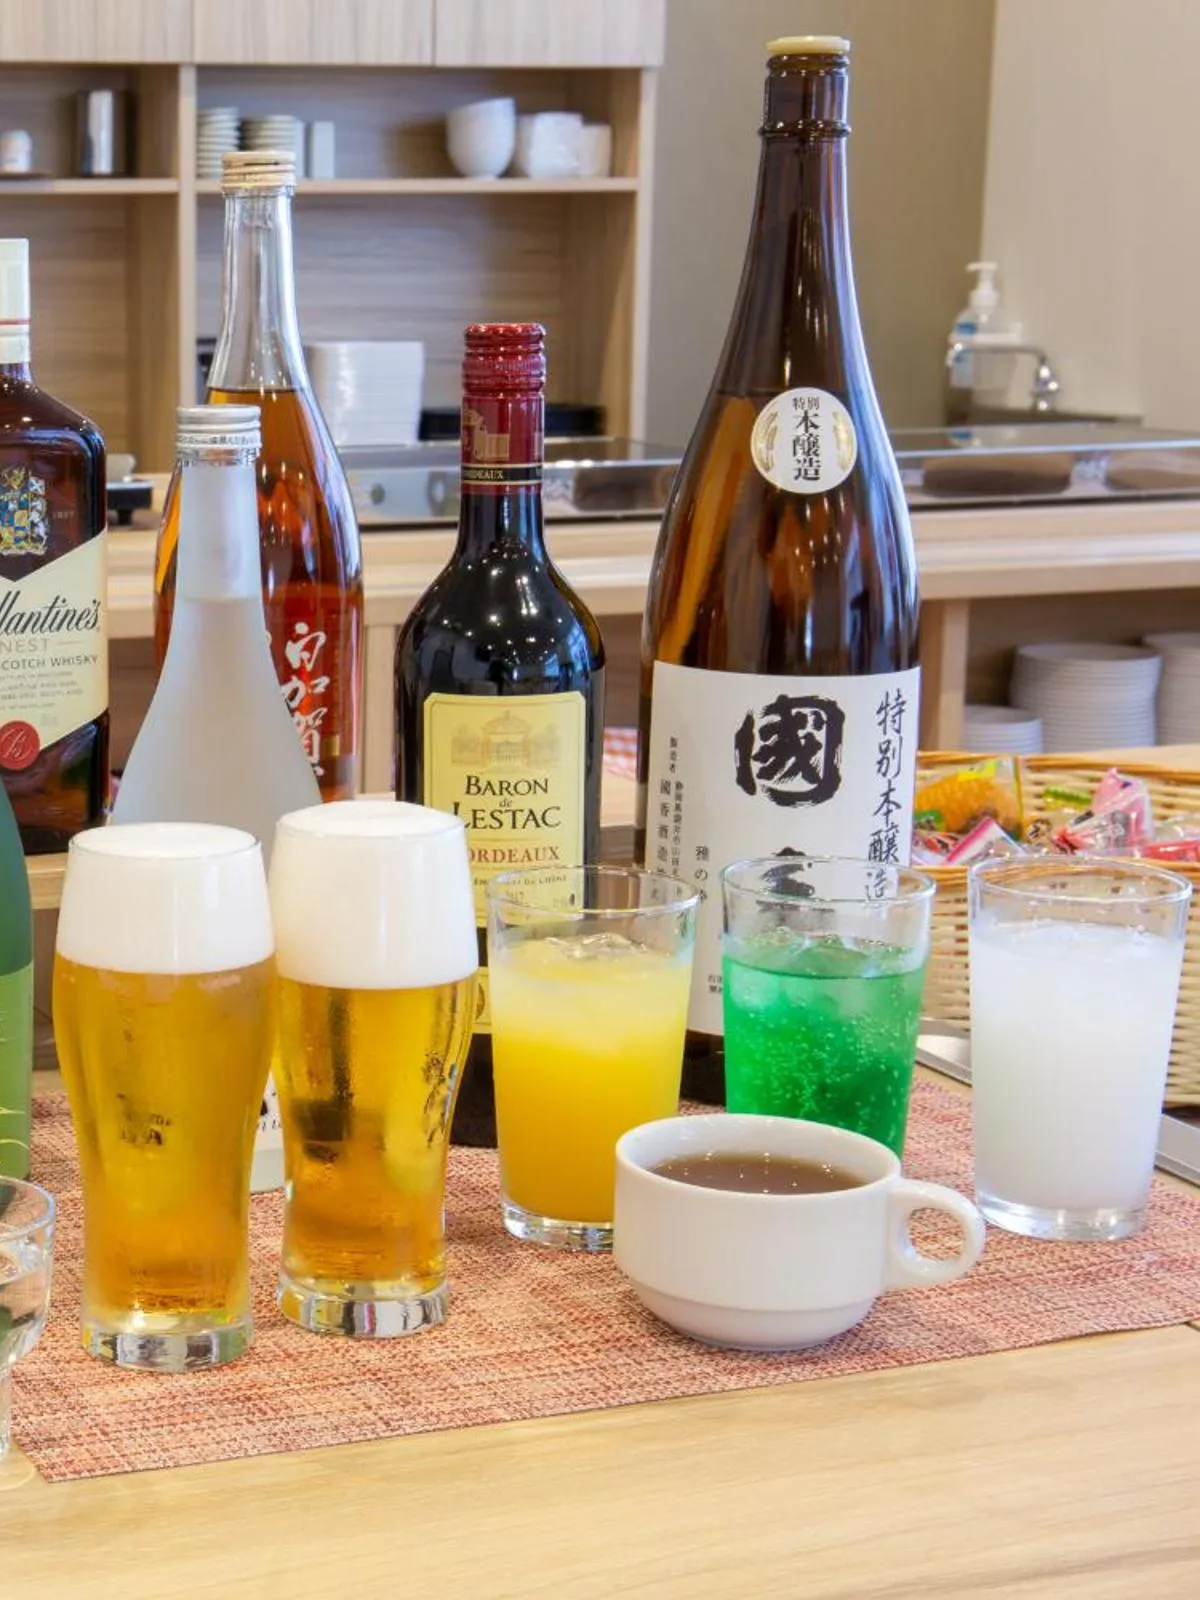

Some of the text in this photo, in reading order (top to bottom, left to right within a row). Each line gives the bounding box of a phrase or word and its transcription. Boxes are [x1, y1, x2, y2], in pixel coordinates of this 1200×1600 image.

[50, 654, 98, 667] WHISKY
[465, 775, 549, 797] BARON
[468, 846, 561, 863] ORDEAUX
